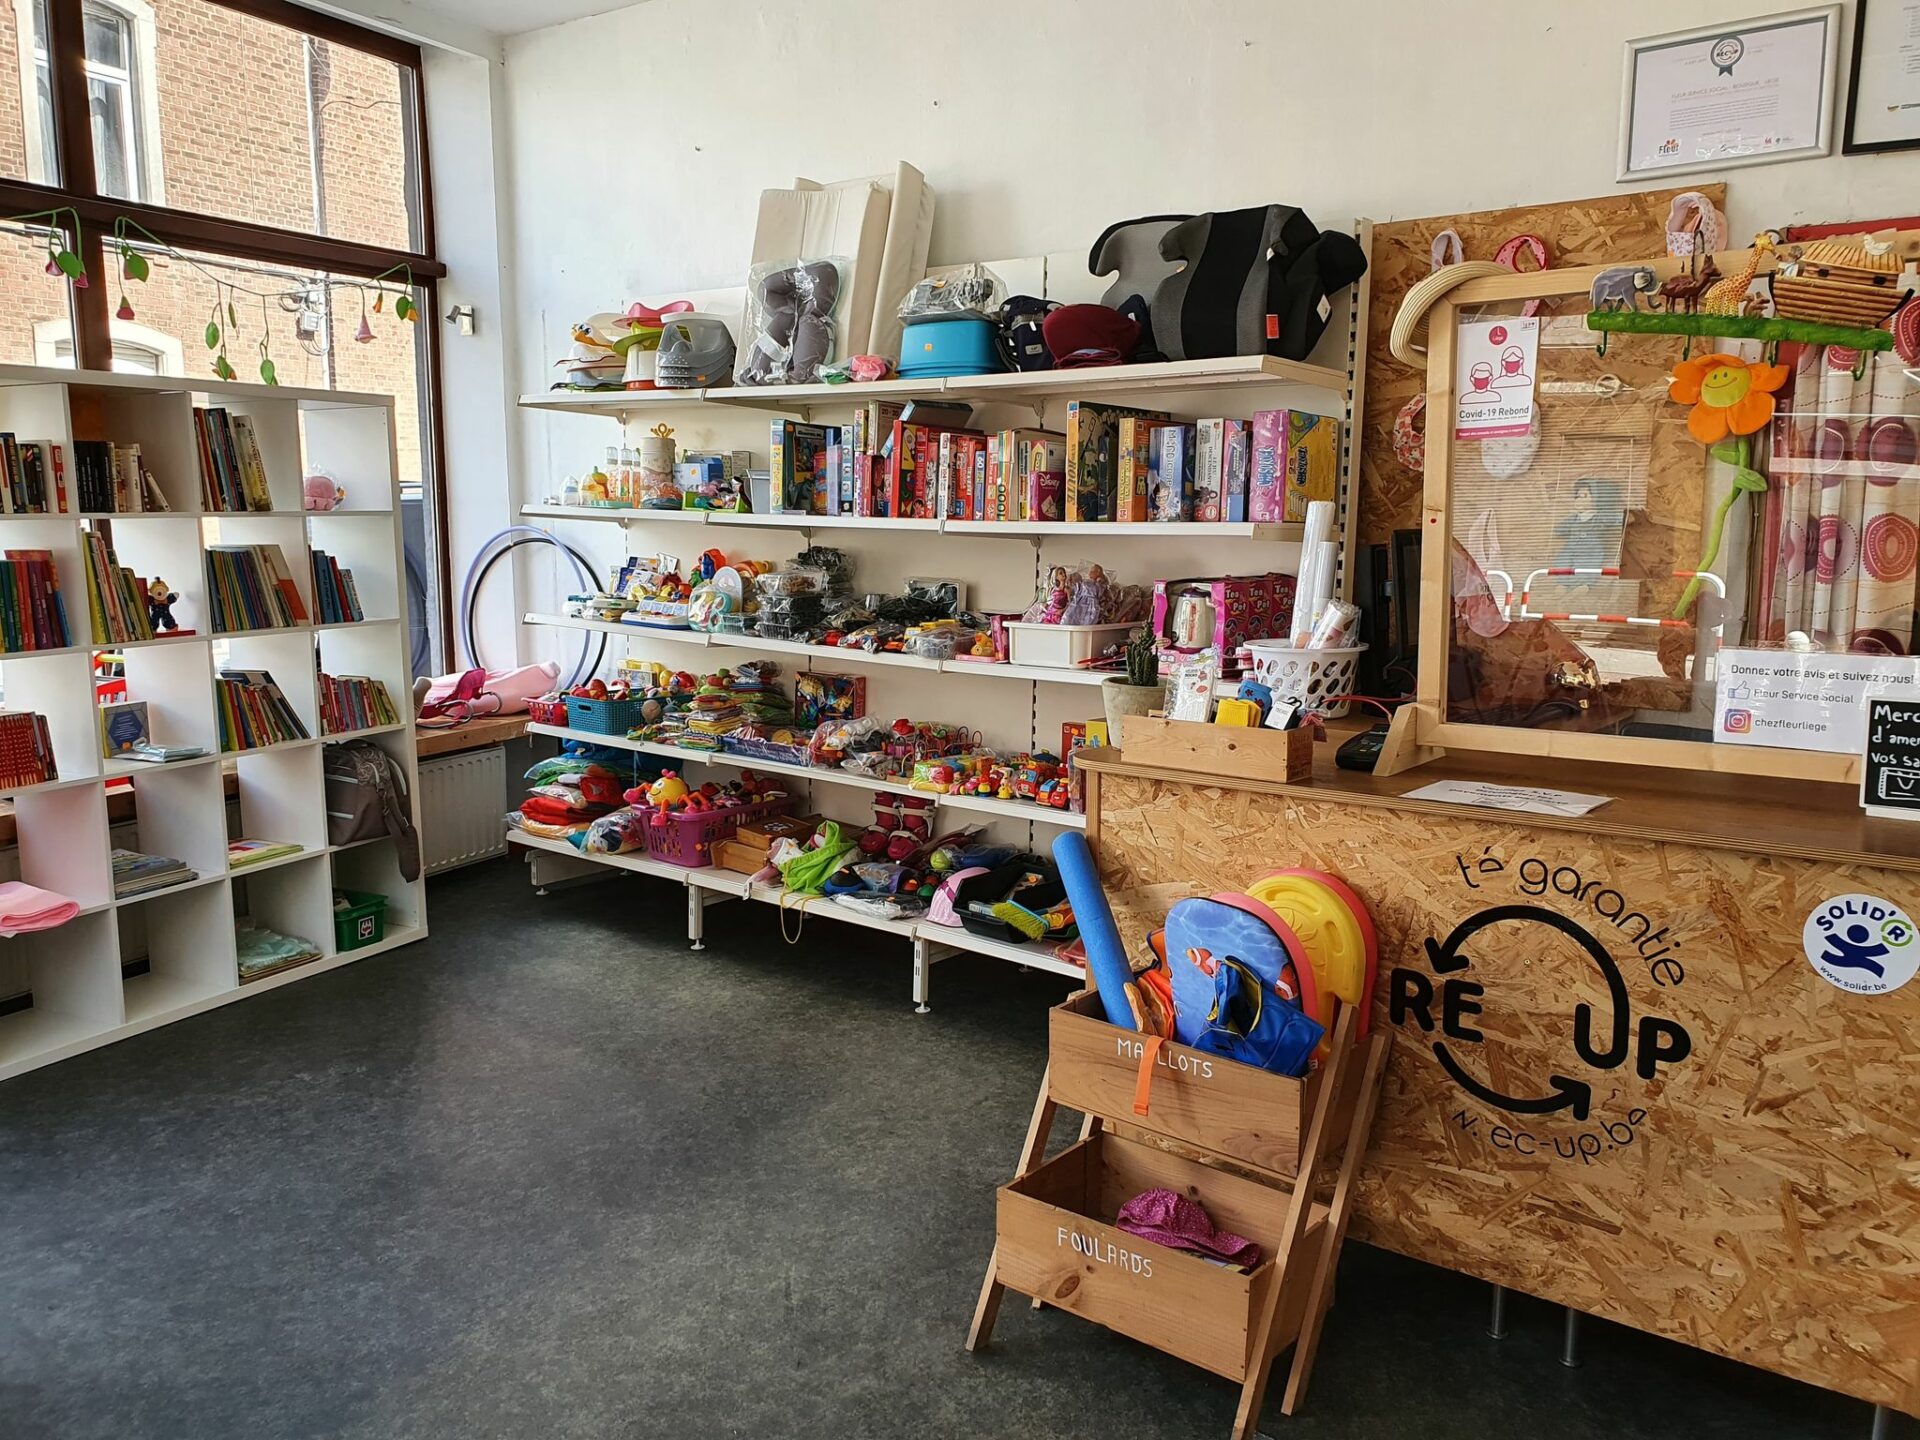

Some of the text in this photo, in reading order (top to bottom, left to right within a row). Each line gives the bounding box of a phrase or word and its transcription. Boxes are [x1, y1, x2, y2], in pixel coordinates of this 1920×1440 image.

[1459, 408, 1497, 419] Covid-19
[1498, 405, 1530, 416] Rebond
[1038, 472, 1060, 490] Disney
[997, 484, 1005, 518] 1000
[1225, 588, 1240, 598] Tea
[1250, 588, 1263, 597] Tea
[1274, 584, 1288, 594] Tea
[1232, 602, 1247, 612] Pot
[1257, 600, 1270, 609] Pot
[1283, 597, 1296, 606] Pot
[1159, 654, 1175, 663] ea
[1731, 665, 1915, 684] Donnez votre avis et suivez nous!
[1753, 689, 1855, 703] Fleur Service Social
[1873, 704, 1920, 723] Merc
[1754, 718, 1827, 732] chezfleurliege
[1871, 752, 1920, 768] Vos sa
[1519, 858, 1685, 987] garantie
[1816, 900, 1906, 942] SOLID'R
[1820, 965, 1888, 992] www.solidr.be
[1389, 967, 1692, 1080] RE UP
[1116, 1037, 1213, 1079] MALLOTS
[1056, 1226, 1153, 1278] FOULARDS
